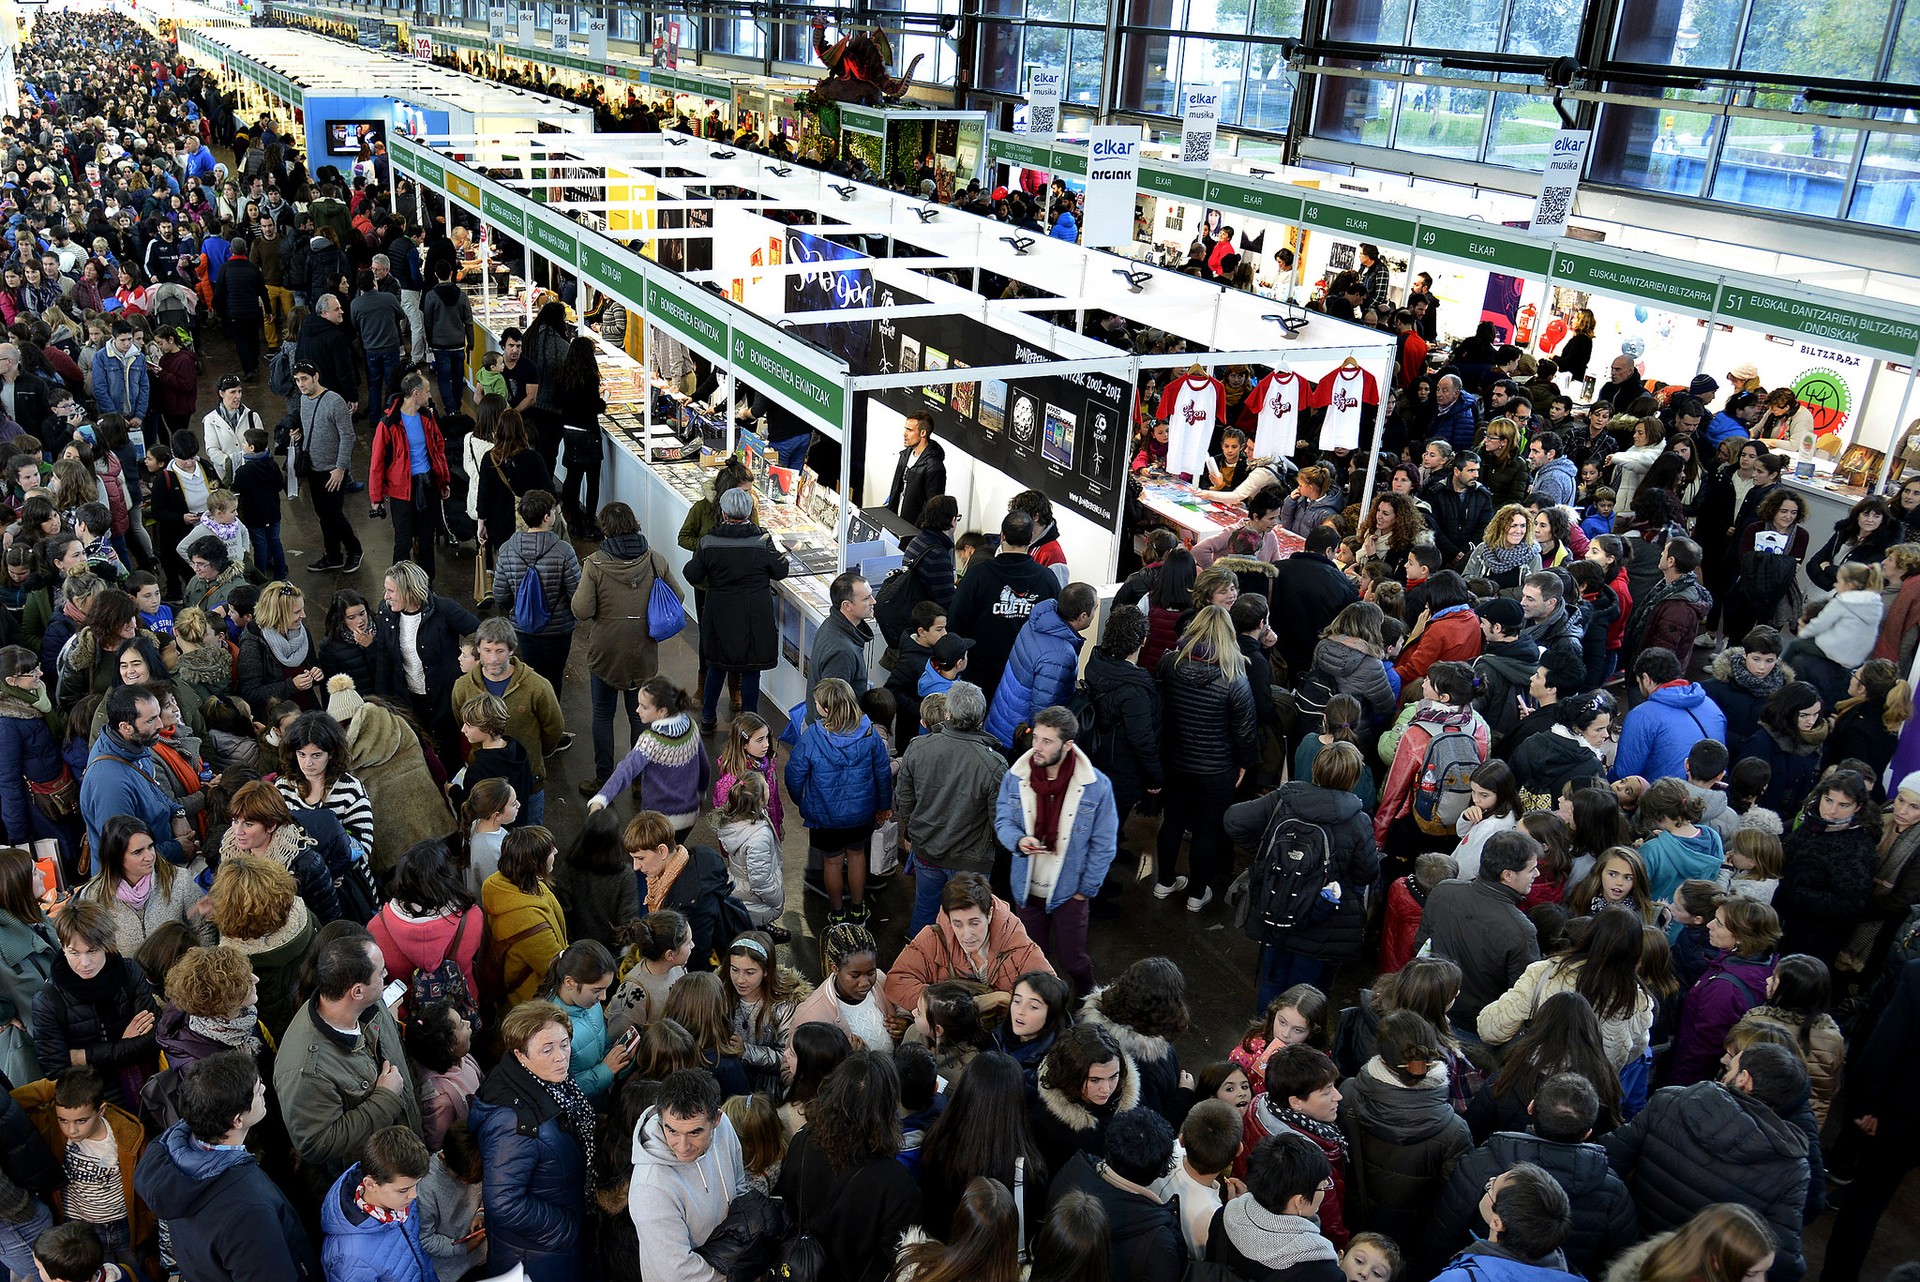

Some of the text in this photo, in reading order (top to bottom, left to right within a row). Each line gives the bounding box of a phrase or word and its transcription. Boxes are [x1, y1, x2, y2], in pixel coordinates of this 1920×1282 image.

[417, 39, 430, 50] YA
[415, 49, 431, 59] NIZ
[1034, 73, 1059, 83] elkar
[1034, 88, 1057, 96] musika
[1189, 92, 1218, 106] elkar
[1188, 109, 1215, 120] musika
[1093, 138, 1135, 156] elkar
[1554, 136, 1586, 153] elkar
[1550, 159, 1579, 172] musika
[1155, 176, 1172, 187] ELKAR
[1210, 187, 1263, 207] 47 ELKAR
[1307, 206, 1369, 231] 48 ELKAR
[527, 220, 534, 235] 45
[1422, 231, 1496, 257] 49 ELKAR
[581, 250, 589, 267] 46
[1559, 258, 1712, 303] 50 EUSKAL DANTZARIEN BILTZARRA
[648, 288, 720, 344] 47 BONBERENEA EKINTZAK
[1726, 293, 1920, 342] 51 EUSKAL DANTZARIEN BILTZARRA
[734, 338, 832, 409] 48 BONBERENEA EKINTZAK
[1086, 376, 1122, 404] 2002-2017
